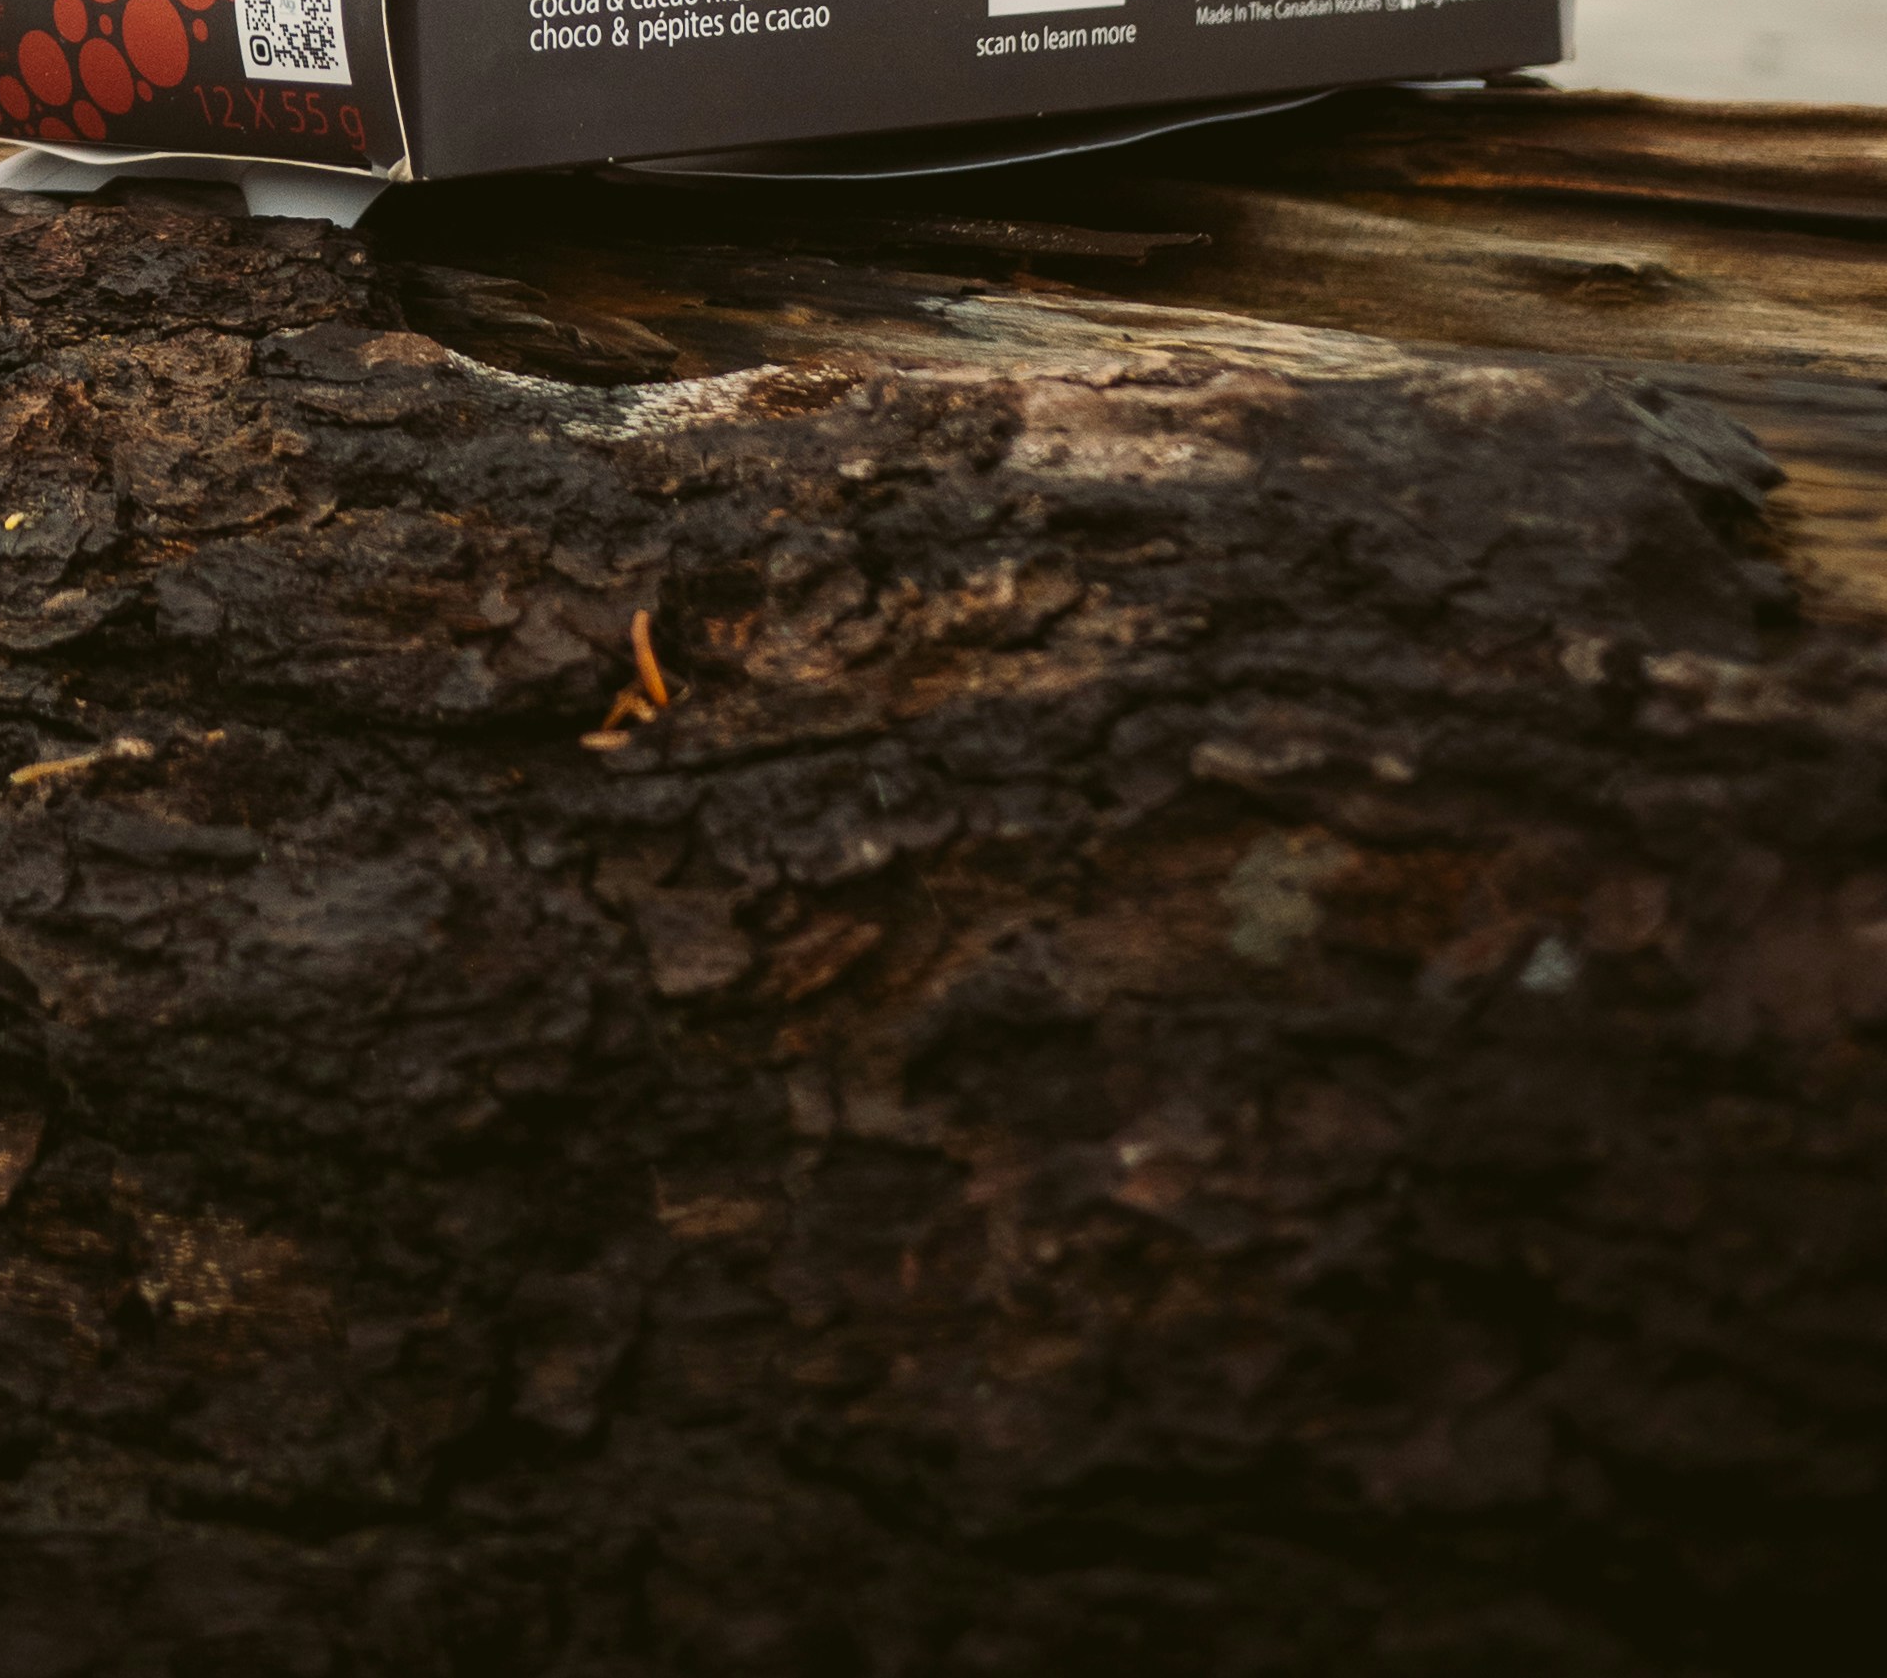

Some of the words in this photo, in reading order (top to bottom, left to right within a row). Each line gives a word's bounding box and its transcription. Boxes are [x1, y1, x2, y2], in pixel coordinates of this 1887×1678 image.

[529, 19, 602, 51] choco
[611, 16, 629, 46] &
[638, 9, 724, 49] pépites
[730, 4, 760, 35] de
[764, 3, 831, 33] cacao
[1196, 4, 1231, 26] Made
[1234, 3, 1247, 23] In
[1248, 0, 1271, 22] The
[976, 31, 1016, 57] scan
[1021, 29, 1040, 53] to
[1043, 23, 1087, 51] learn
[1091, 21, 1136, 47] more
[193, 85, 242, 129] 12
[281, 90, 329, 135] 55
[339, 104, 366, 152] g
